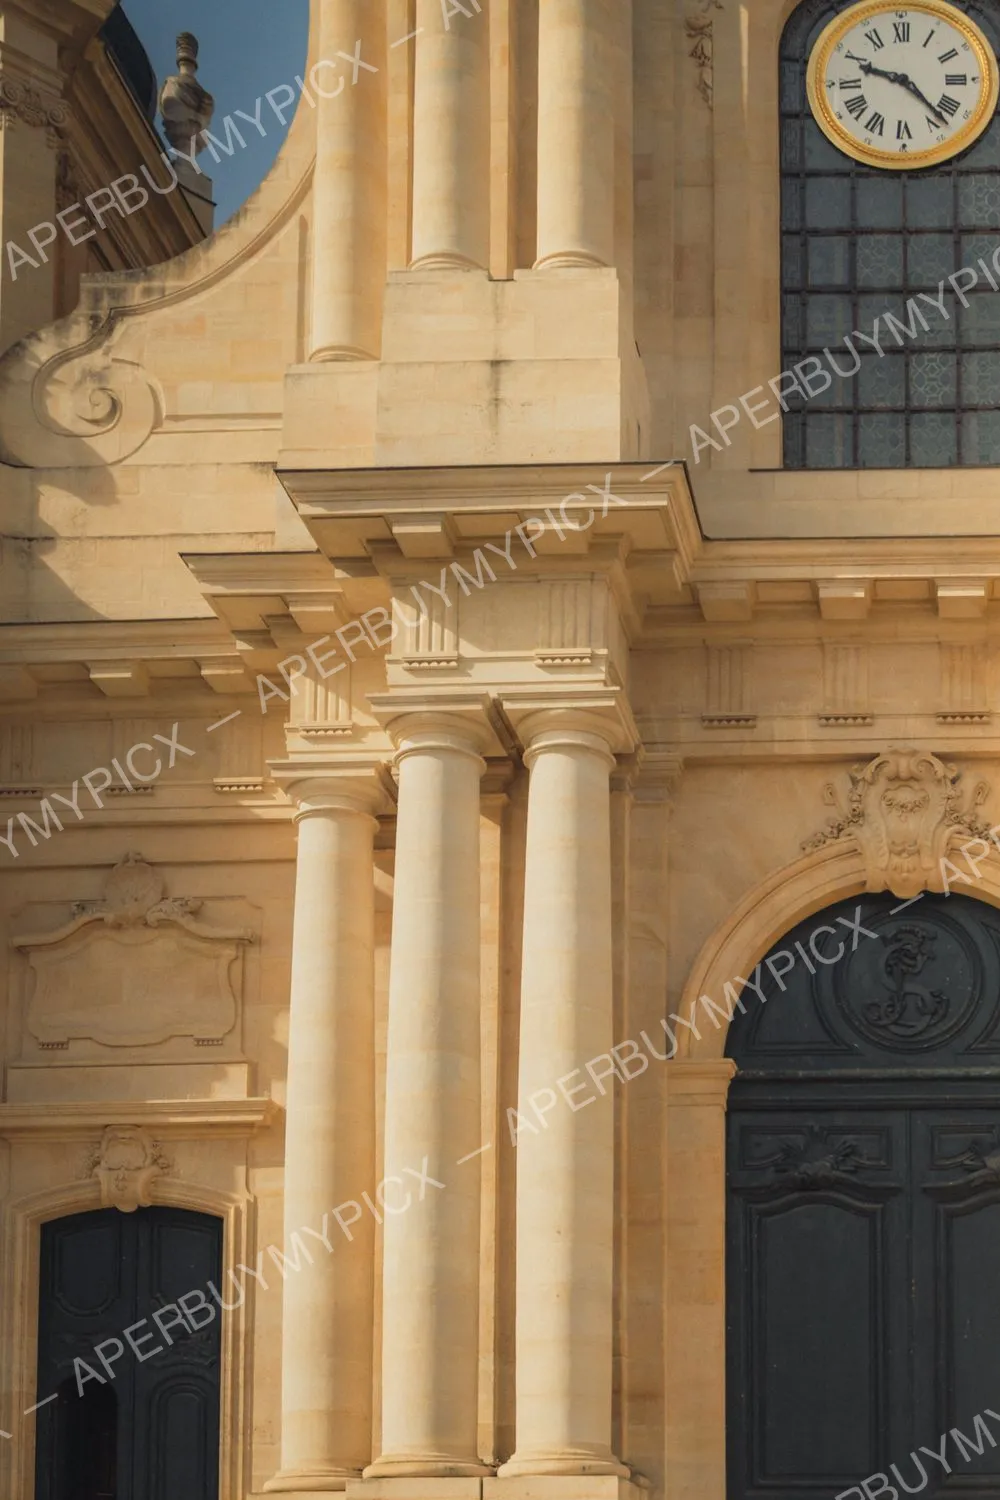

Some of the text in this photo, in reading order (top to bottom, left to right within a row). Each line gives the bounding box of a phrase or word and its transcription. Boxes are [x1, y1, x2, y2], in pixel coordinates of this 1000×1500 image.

[864, 28, 884, 52] XI
[892, 22, 910, 43] XII
[937, 48, 959, 64] II
[945, 74, 967, 86] III
[844, 94, 869, 122] VIII
[864, 112, 885, 136] VII
[896, 120, 912, 139] VI
